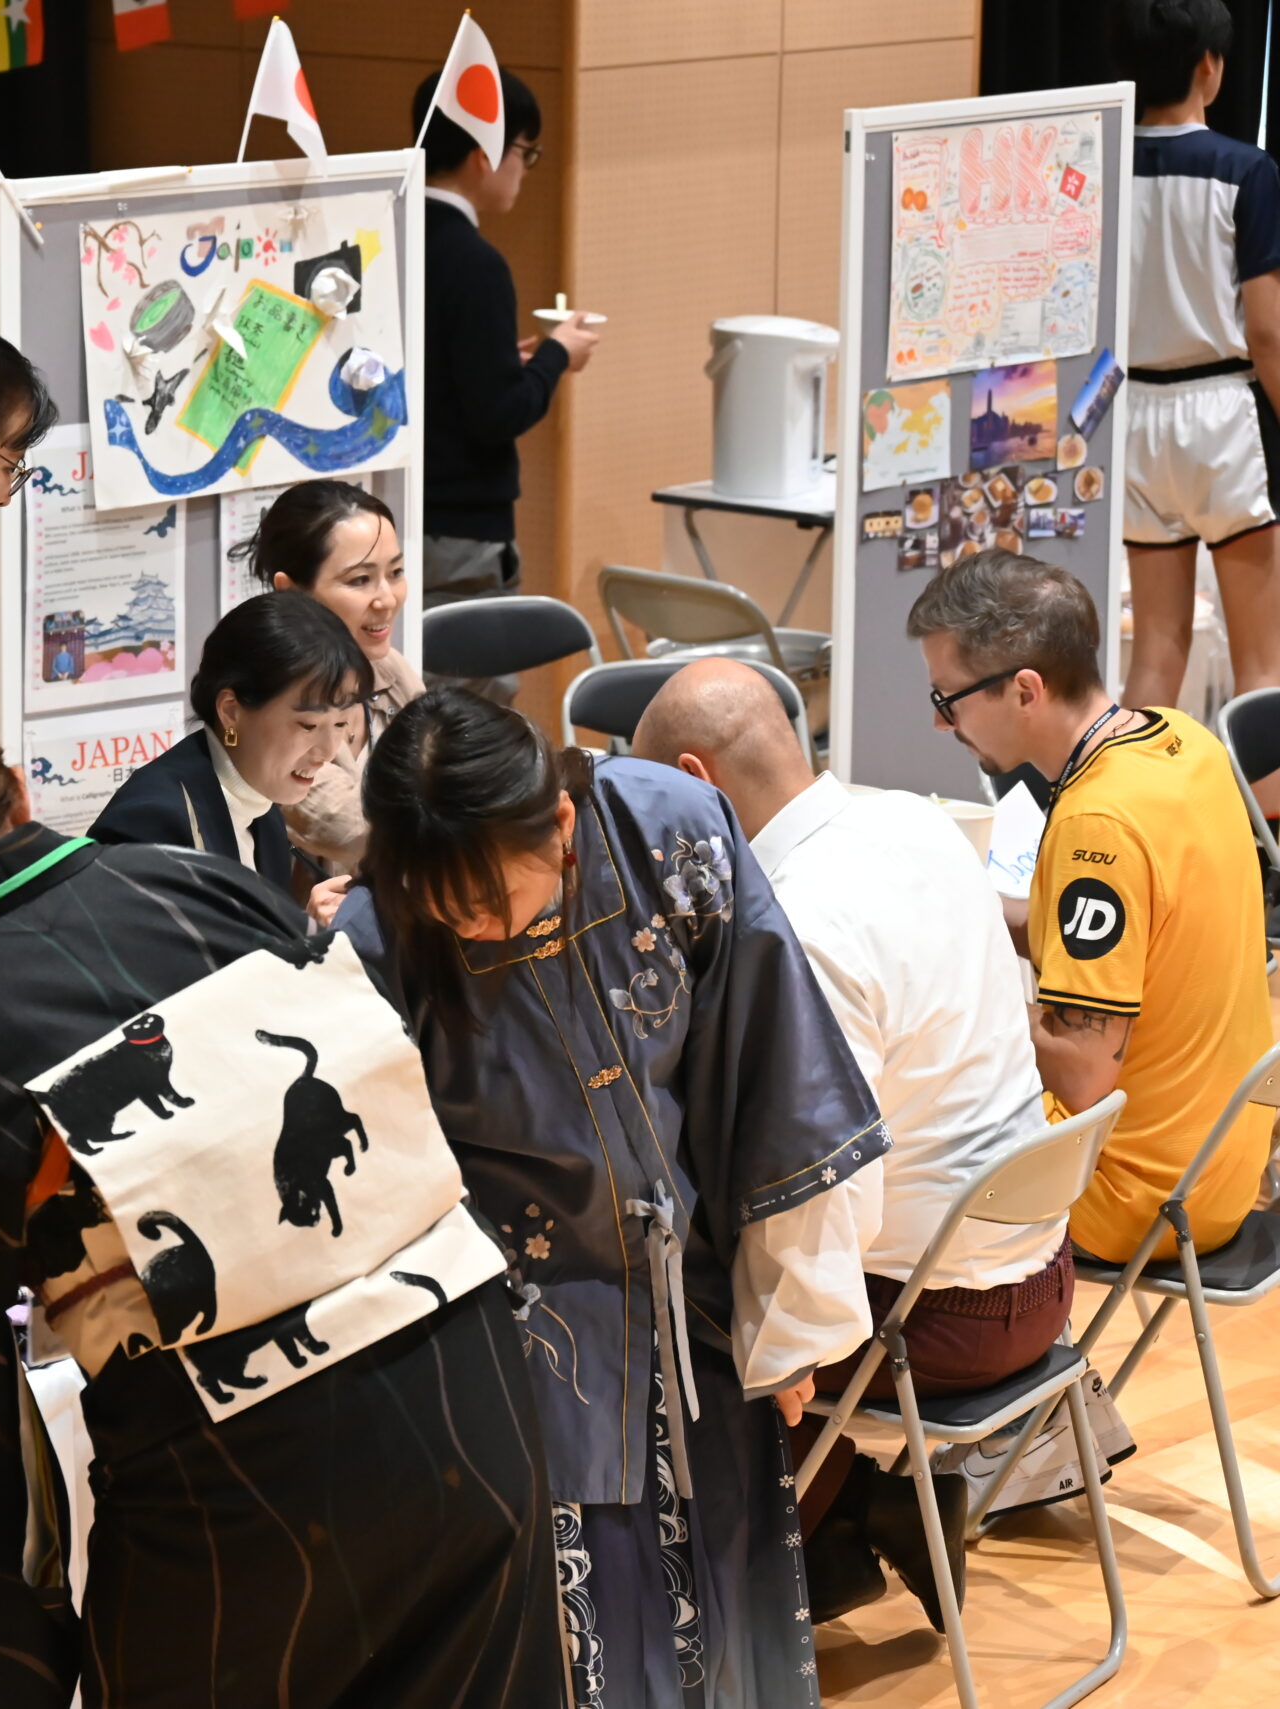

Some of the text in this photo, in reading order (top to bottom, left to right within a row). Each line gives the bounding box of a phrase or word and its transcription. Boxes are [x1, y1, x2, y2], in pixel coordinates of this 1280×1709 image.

[959, 123, 1058, 217] HK
[71, 730, 173, 771] JAPAN
[1072, 849, 1117, 865] SUDU
[1063, 896, 1117, 940] JD
[1059, 1478, 1073, 1490] AIR
